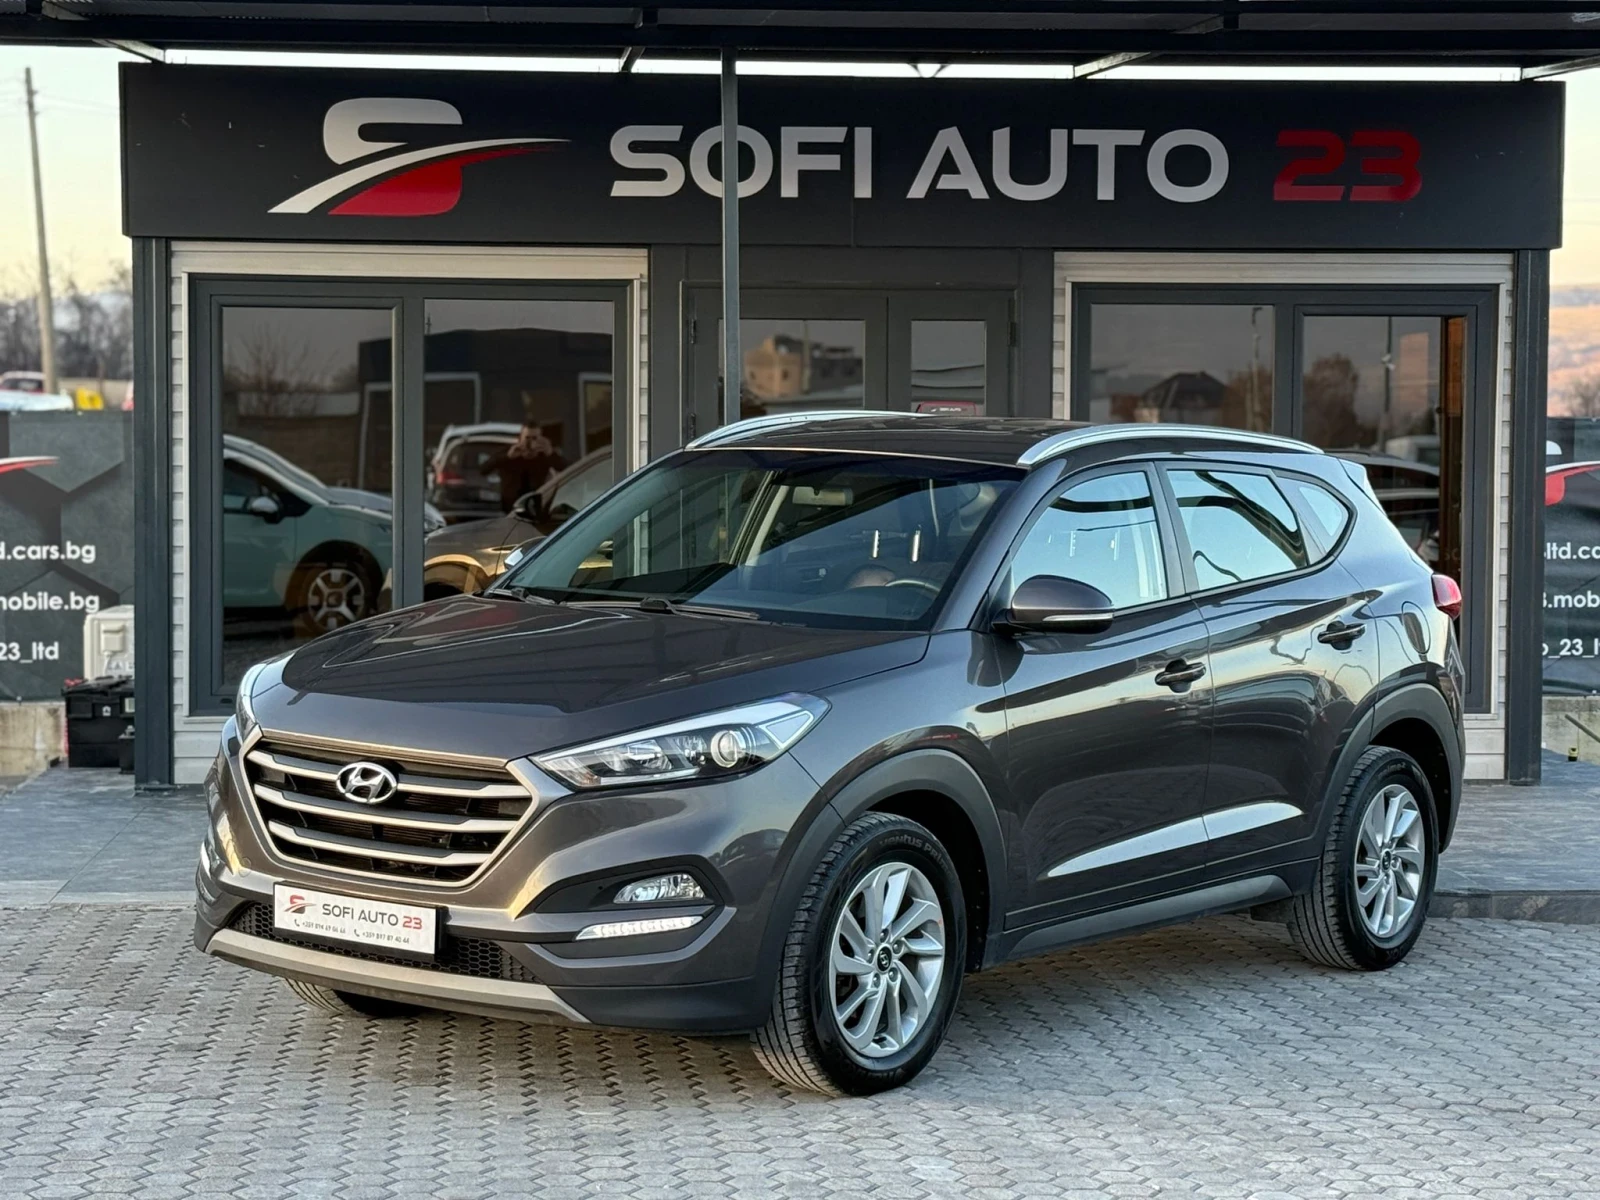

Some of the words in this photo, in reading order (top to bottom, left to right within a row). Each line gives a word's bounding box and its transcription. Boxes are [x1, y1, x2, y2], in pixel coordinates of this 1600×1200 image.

[609, 124, 872, 199] SOFI
[906, 125, 1230, 203] AUTO
[1272, 129, 1423, 202] 23
[322, 903, 354, 920] SOFI
[358, 909, 399, 926] AUTO
[402, 915, 423, 930] 23
